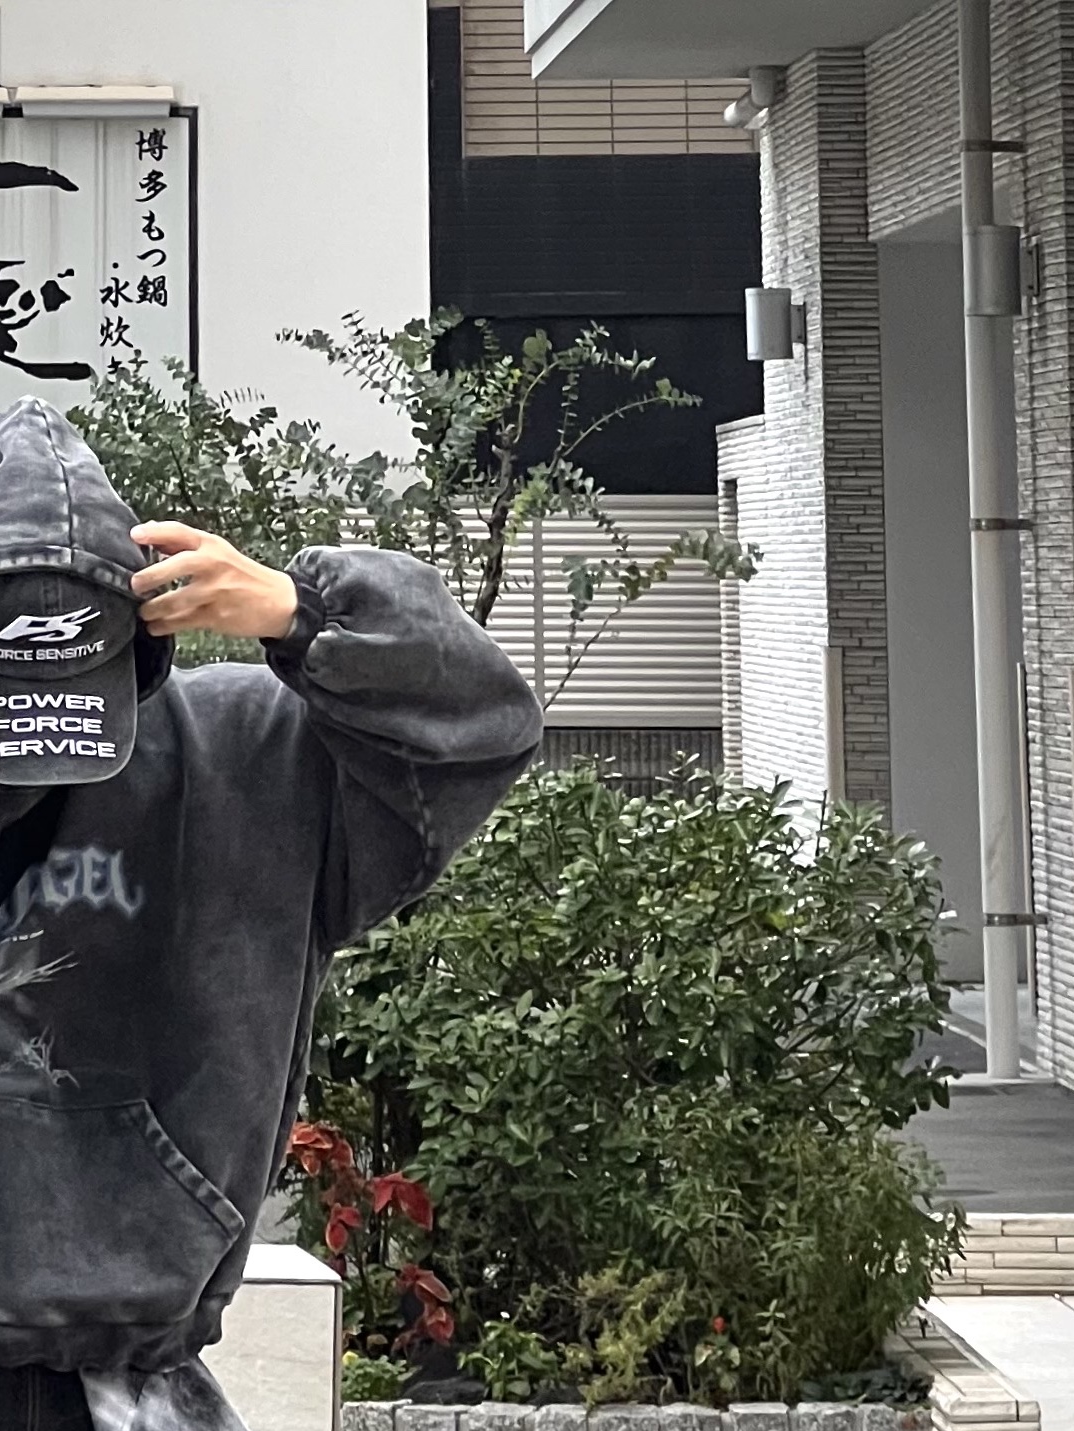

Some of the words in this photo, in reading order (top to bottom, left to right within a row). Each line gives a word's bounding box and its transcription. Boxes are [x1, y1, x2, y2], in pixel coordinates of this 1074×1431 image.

[134, 128, 168, 307] 博多もつ鍋
[36, 640, 105, 660] SENSITIVE
